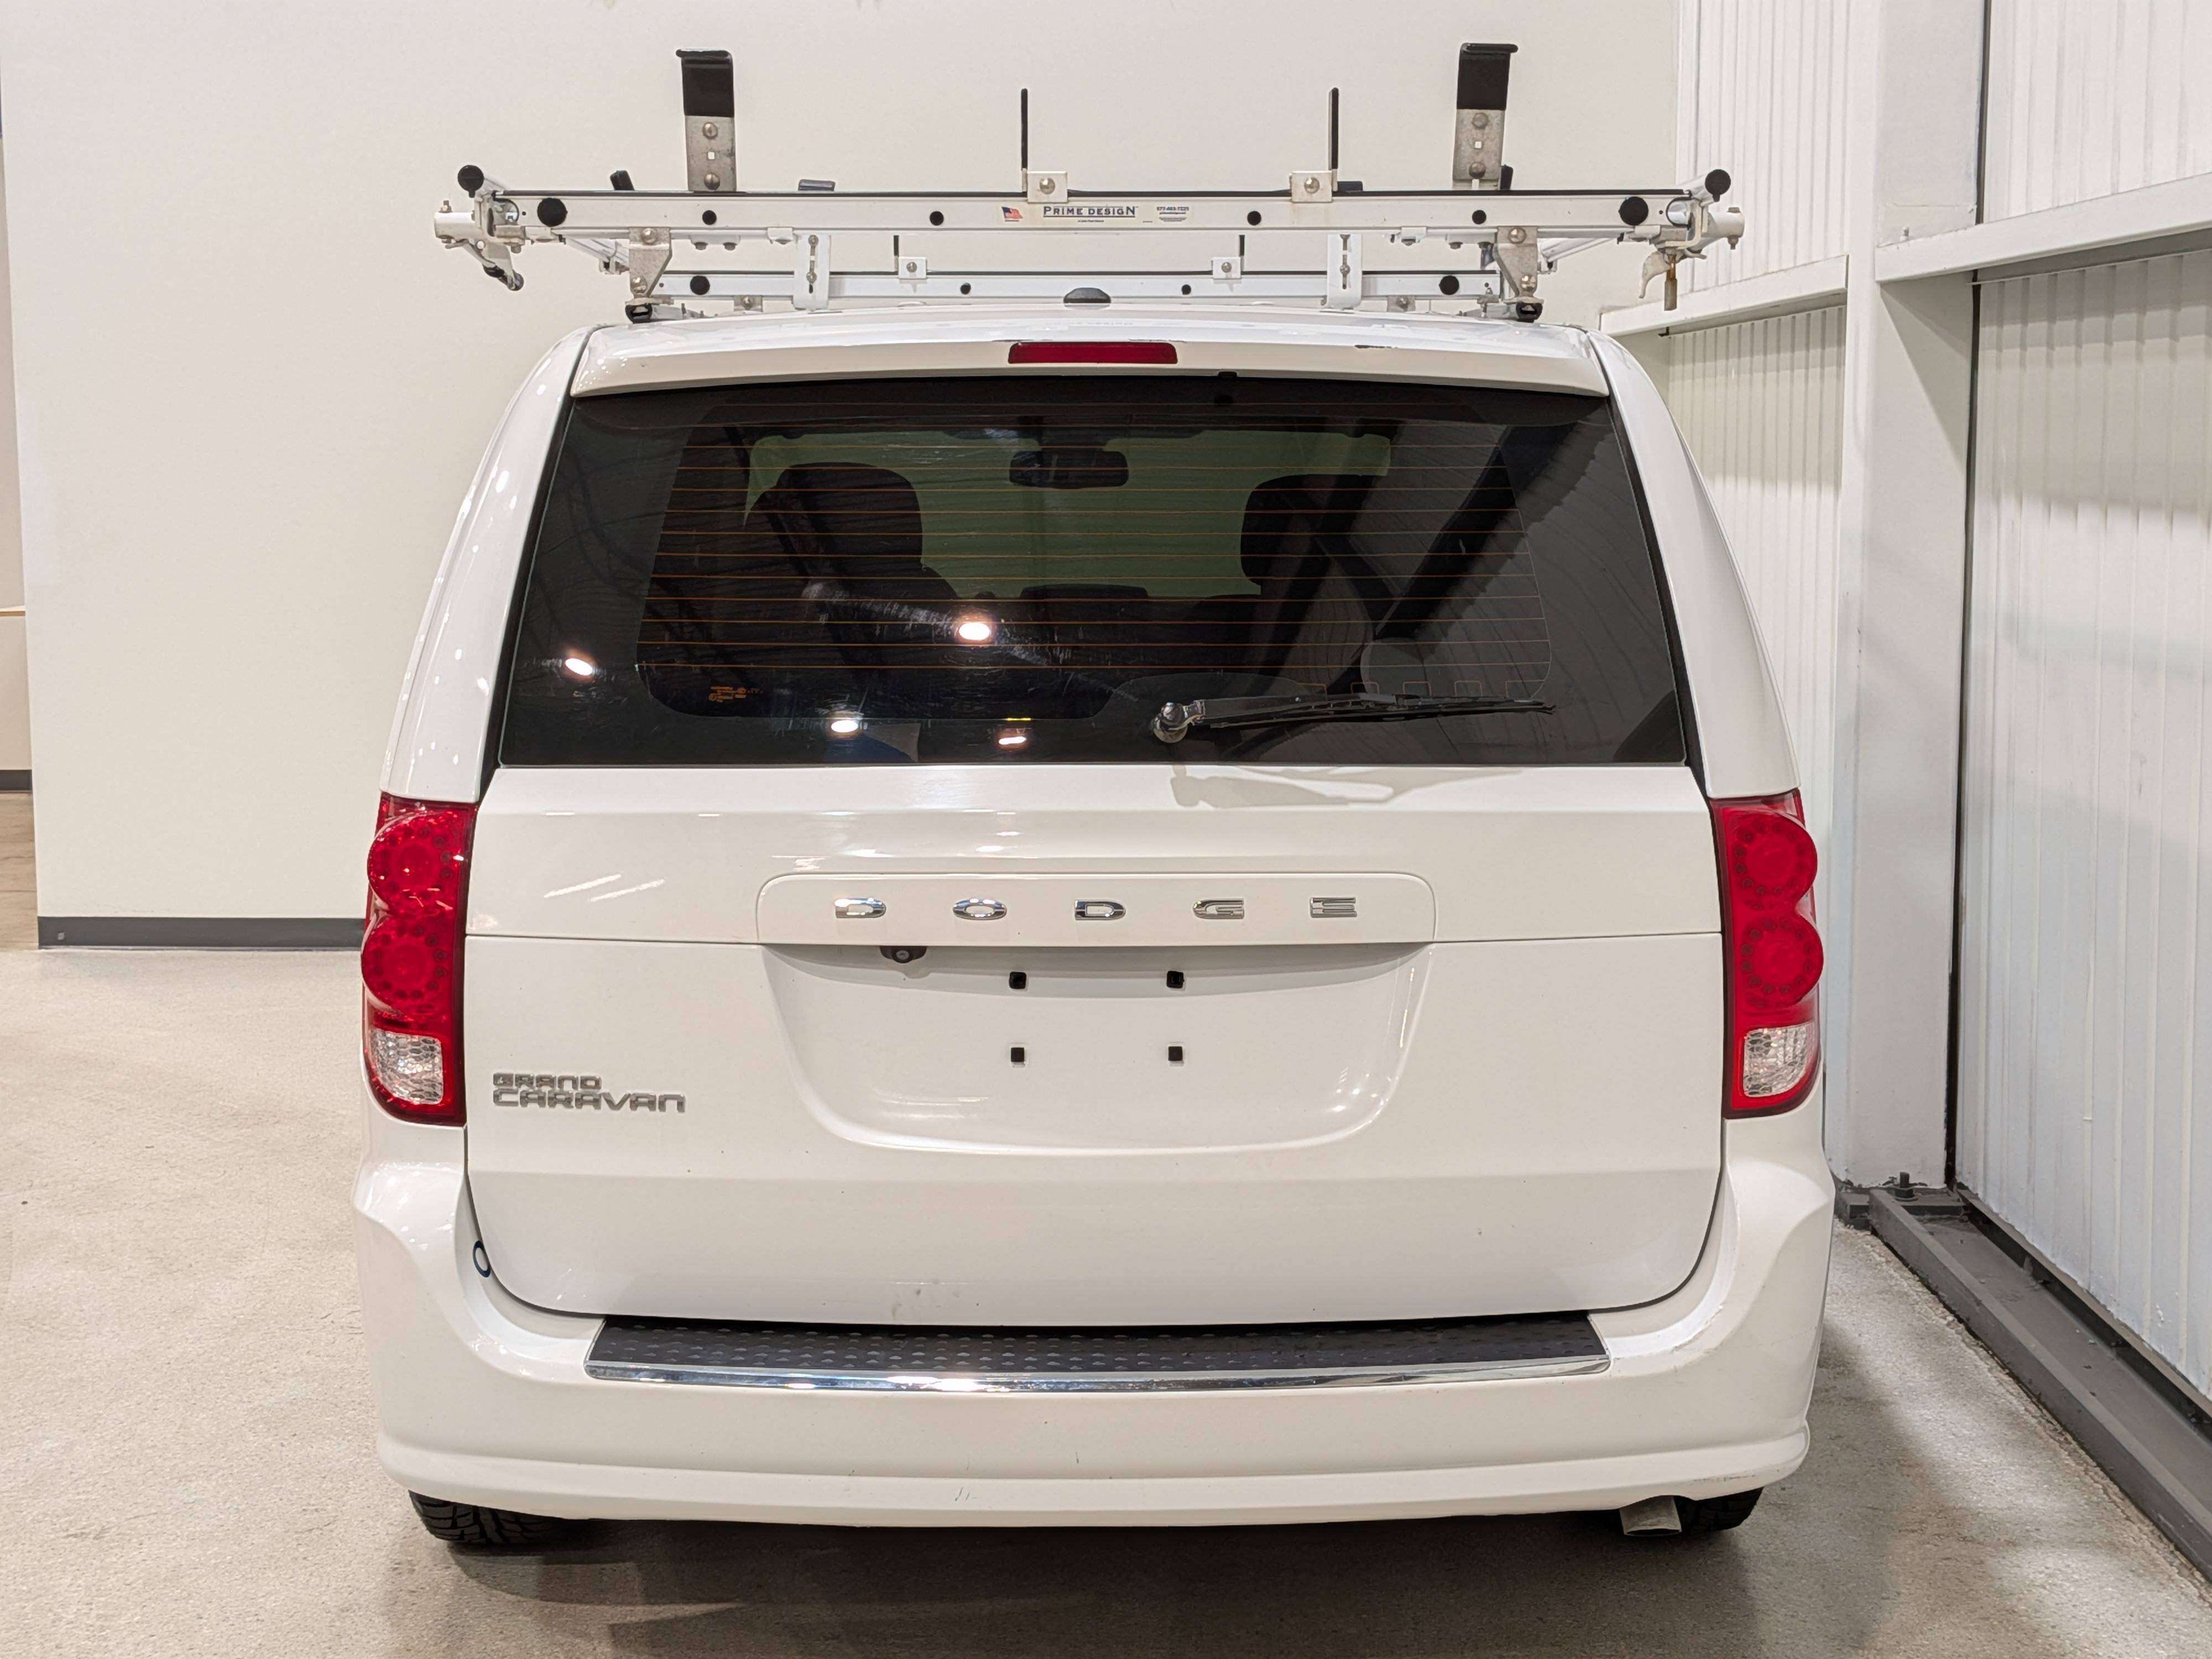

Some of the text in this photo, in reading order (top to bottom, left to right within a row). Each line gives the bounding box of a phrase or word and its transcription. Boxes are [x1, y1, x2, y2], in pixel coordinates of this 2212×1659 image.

[1043, 206, 1136, 216] PRIME DESIGN
[834, 896, 1358, 921] DODGE
[493, 1073, 602, 1090] GRAND
[493, 1088, 686, 1113] CARAVAN
